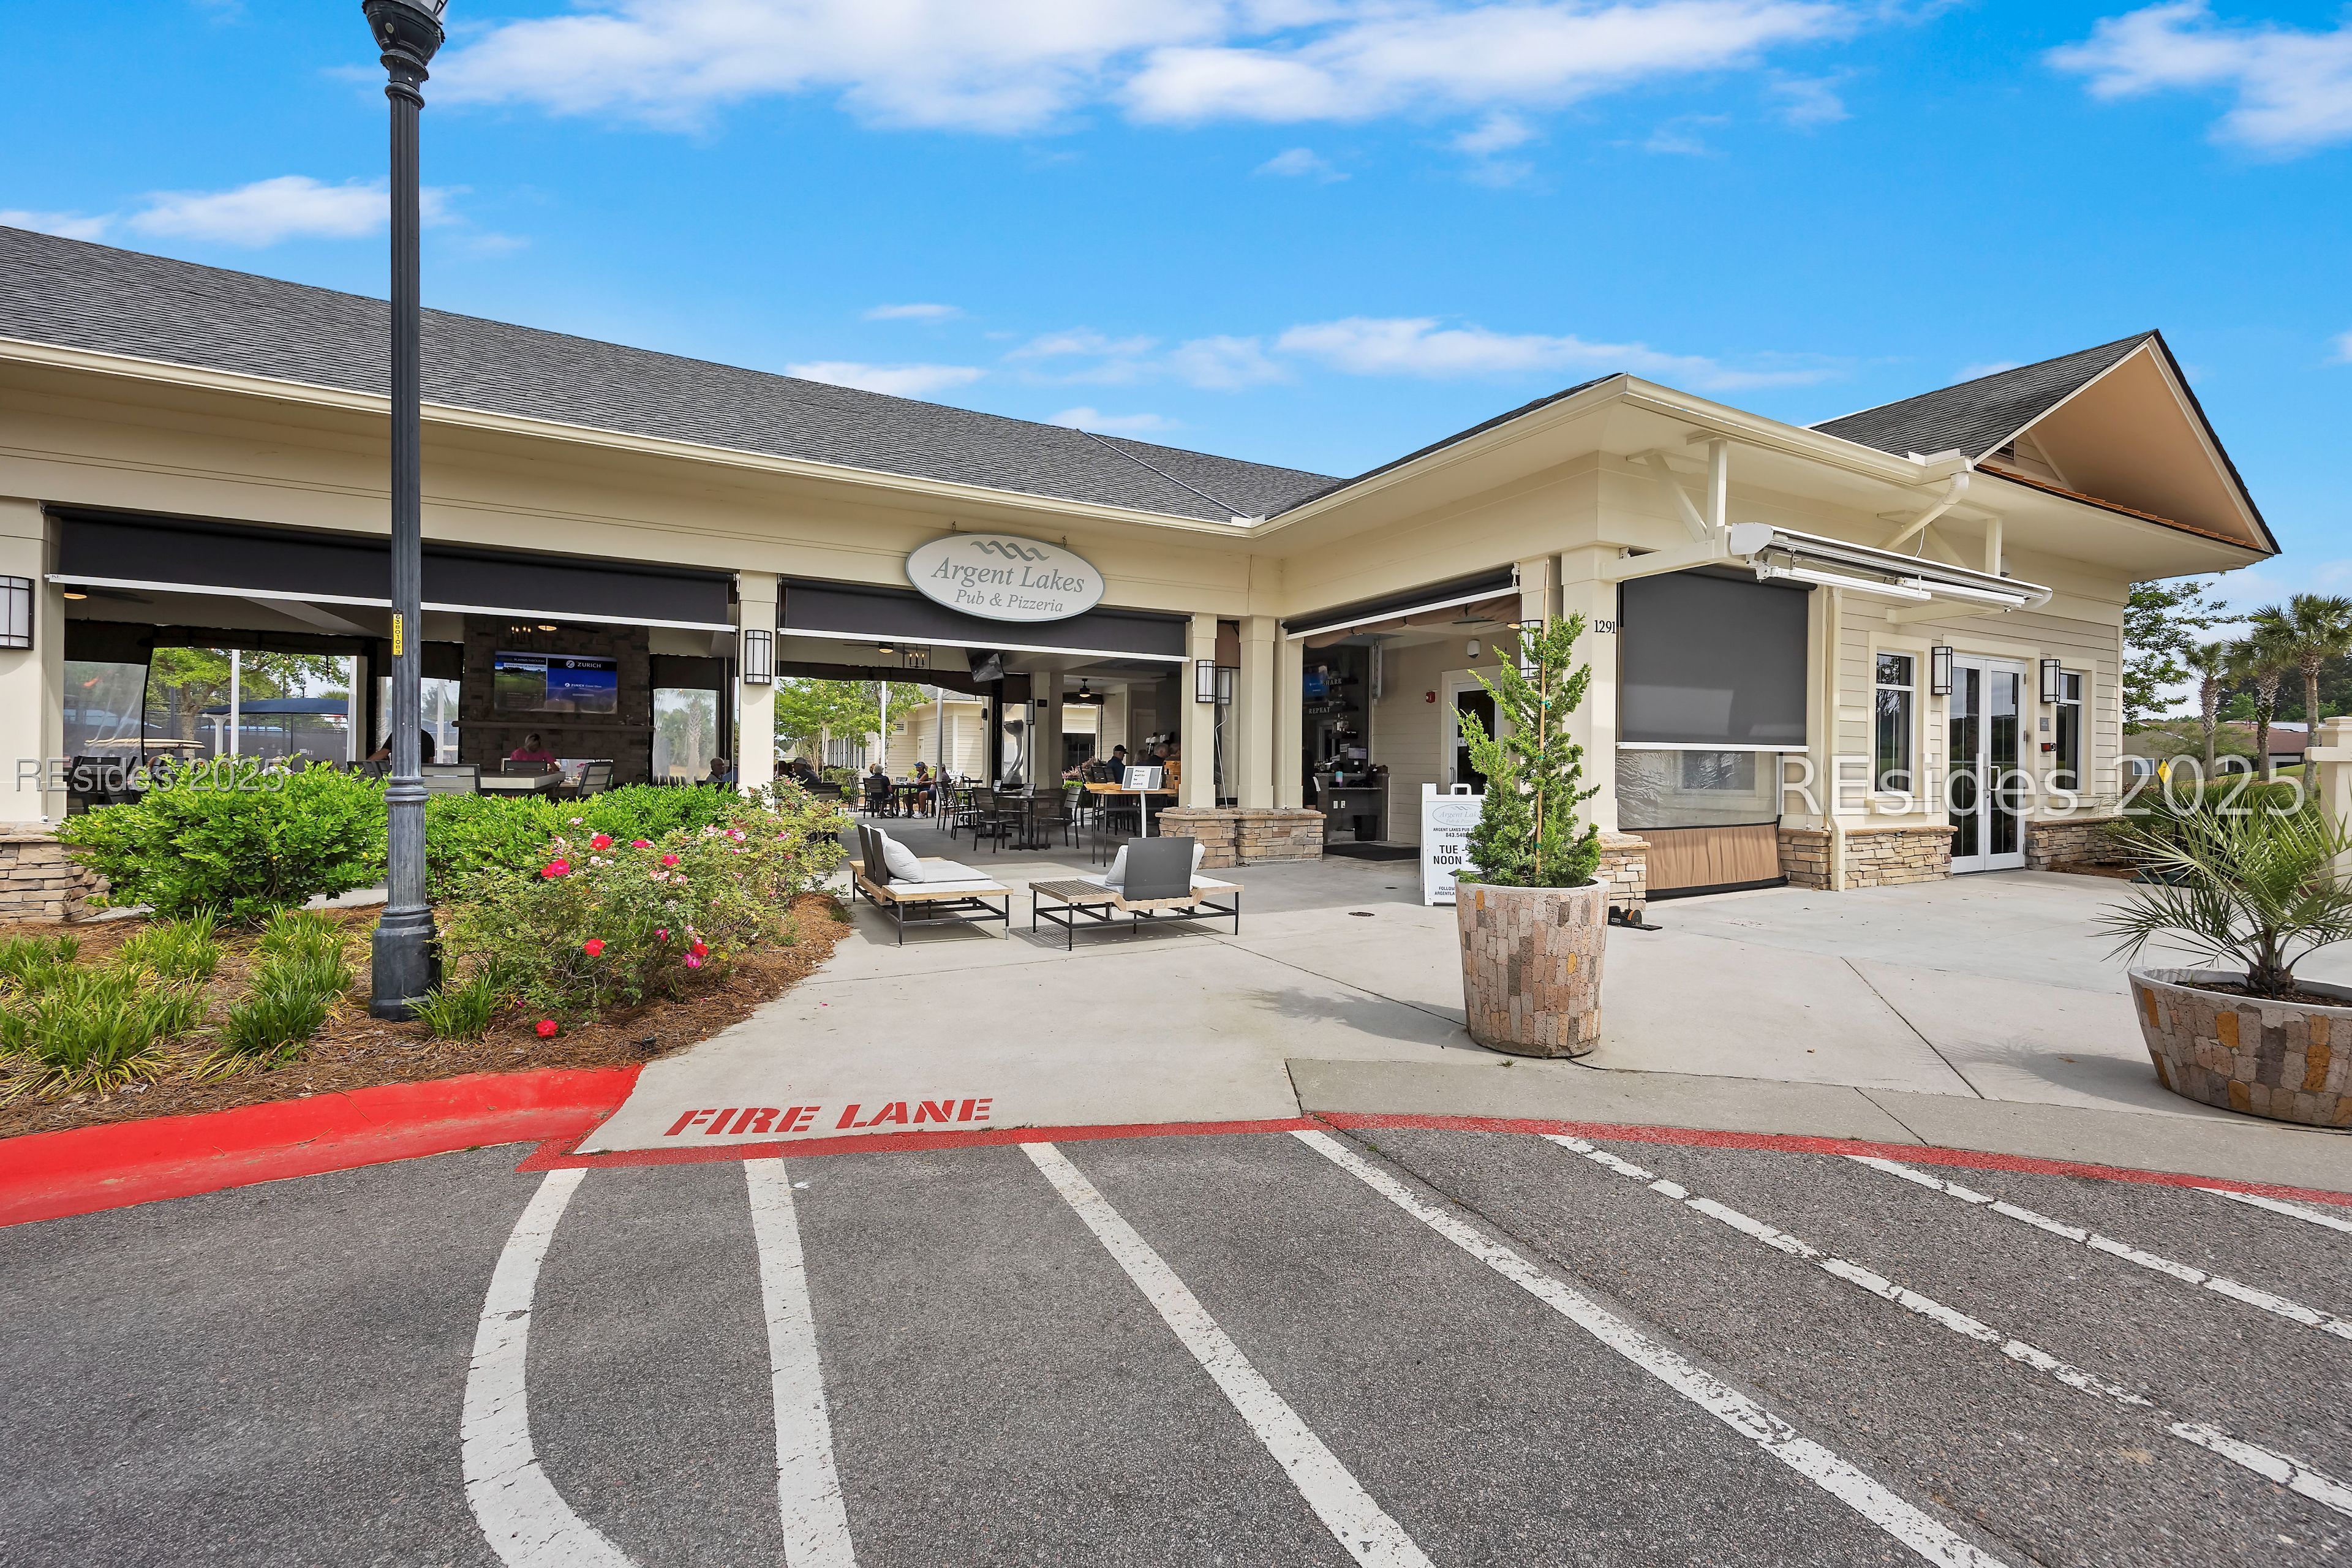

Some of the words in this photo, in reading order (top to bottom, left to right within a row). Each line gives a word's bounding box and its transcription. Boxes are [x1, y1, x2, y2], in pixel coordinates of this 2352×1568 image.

[931, 556, 1014, 588] Argent
[1019, 565, 1085, 594] Lakes
[954, 589, 985, 605] Pub
[989, 592, 1003, 607] &
[1006, 594, 1064, 612] Pizzeria
[1594, 619, 1618, 634] 1291
[1439, 845, 1458, 854] TUE
[1433, 856, 1461, 864] NOON
[663, 1106, 821, 1136] FIRE
[835, 1098, 993, 1129] LANE
